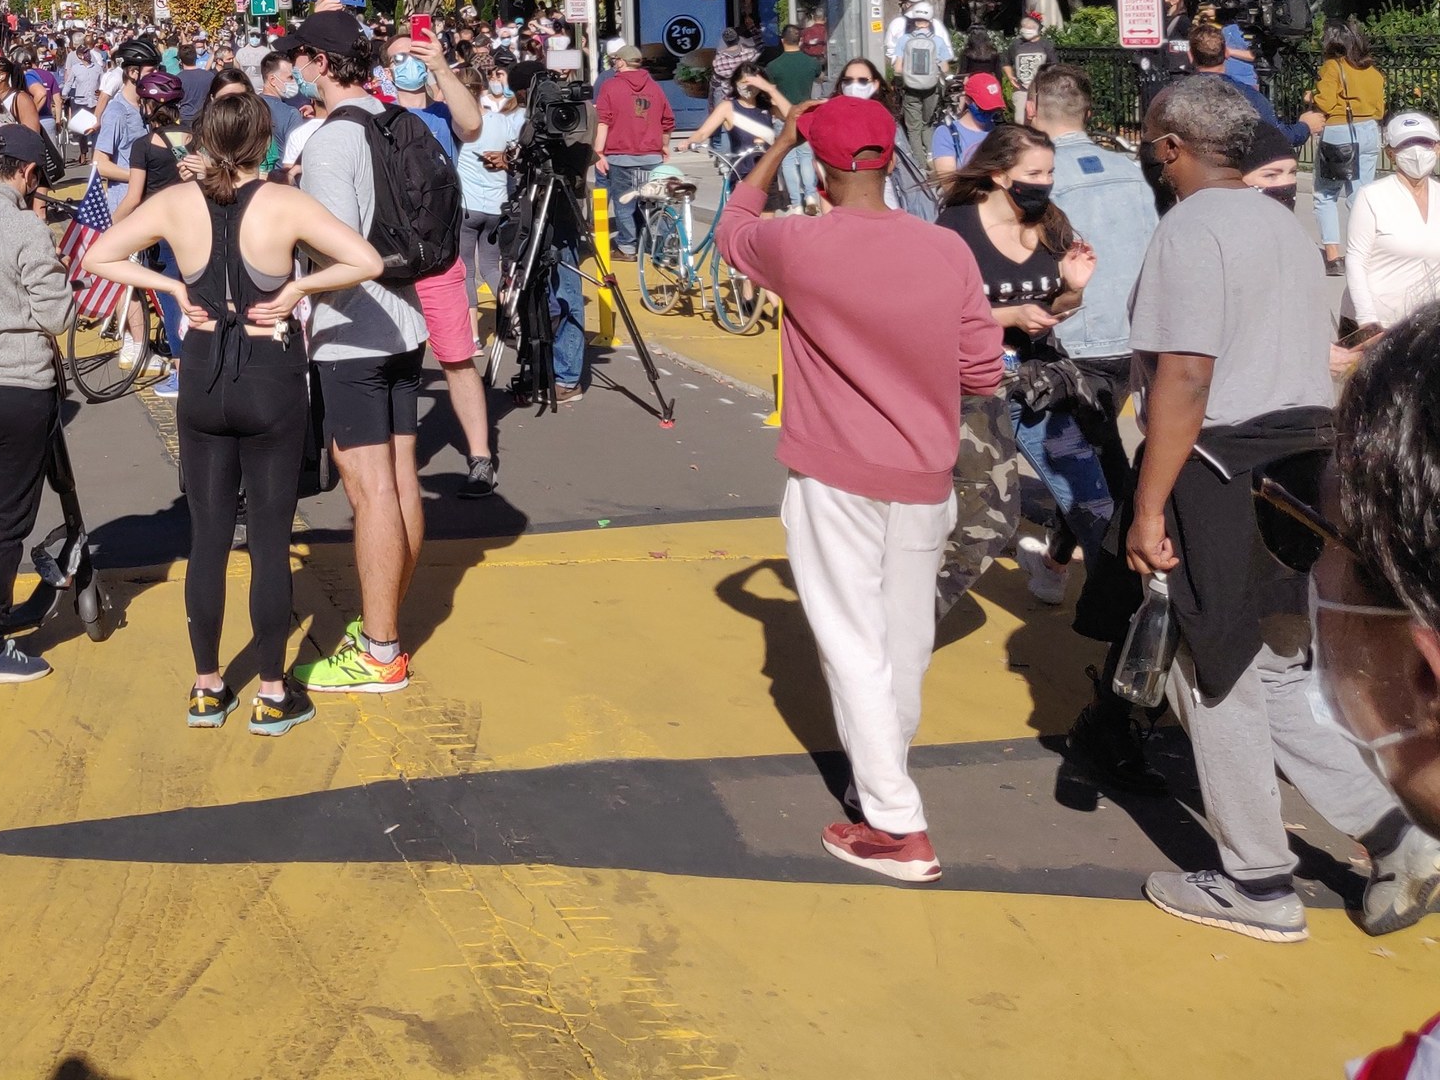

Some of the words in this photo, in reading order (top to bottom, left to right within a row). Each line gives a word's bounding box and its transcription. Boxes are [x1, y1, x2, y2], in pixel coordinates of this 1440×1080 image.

[670, 25, 681, 37] 2
[681, 26, 697, 35] for
[676, 37, 691, 50] $3
